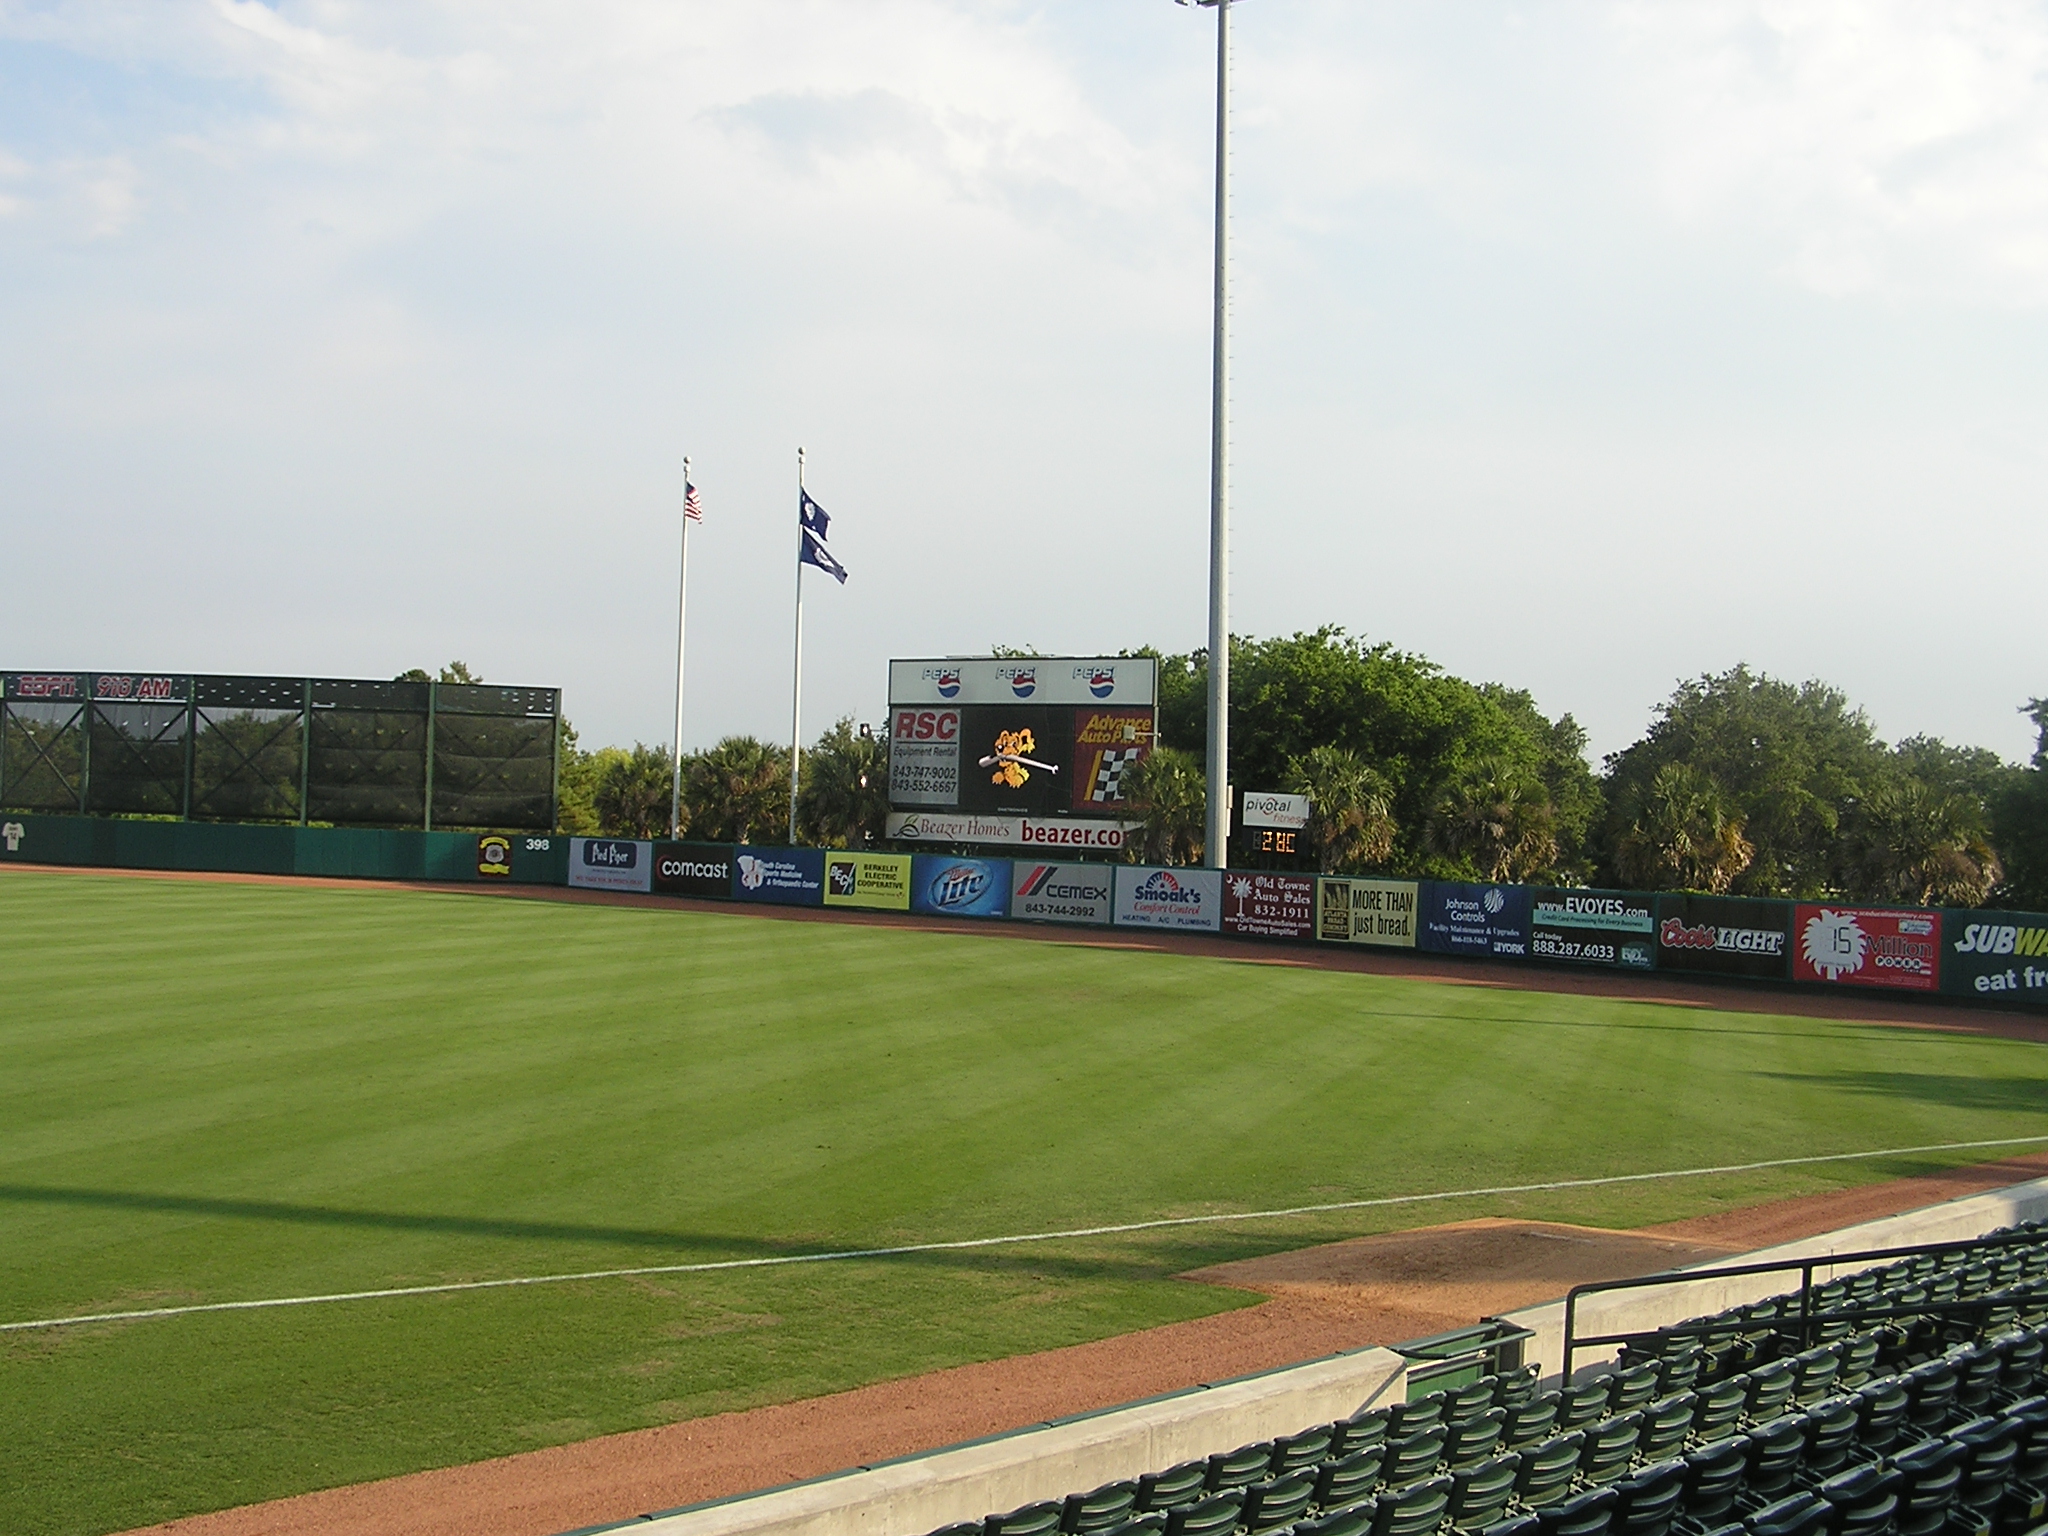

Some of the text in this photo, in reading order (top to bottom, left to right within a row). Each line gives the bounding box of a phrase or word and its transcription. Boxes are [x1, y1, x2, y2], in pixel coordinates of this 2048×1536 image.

[922, 667, 962, 680] PEPSI
[995, 666, 1039, 680] PEPSI
[1072, 666, 1117, 680] PEPSI
[19, 676, 76, 697] ESPN
[97, 676, 172, 697] 910 AM
[895, 712, 958, 740] RSC
[1085, 714, 1152, 731] Advance
[1077, 730, 1112, 743] Auto
[894, 746, 957, 758] Equipment Rental
[893, 765, 956, 779] 843-747-9002
[891, 779, 957, 793] 843-552-6667
[1246, 800, 1291, 812] pivotal
[920, 818, 1010, 839] Beazer Homes
[526, 838, 550, 850] 398
[591, 842, 629, 865] Pied Piper
[661, 861, 728, 878] comcast
[863, 864, 899, 872] BERKELEY
[857, 879, 904, 889] COOPERATIVE
[865, 872, 897, 881] ELECTRIC
[1255, 876, 1310, 891] Old Towne
[1046, 885, 1107, 900] CEMEX
[1135, 886, 1201, 903] Smoak's
[1253, 888, 1311, 905] Auto Sales
[1133, 901, 1201, 915] Comfort Control
[1353, 890, 1413, 912] MORE THAN
[1445, 899, 1479, 911] Johnson
[1537, 897, 1649, 918] www.EVOYES.com
[1026, 903, 1095, 917] 843-744-2992
[1254, 904, 1309, 919] 832-1911
[1451, 911, 1485, 923] Controls
[1123, 914, 1211, 927] HEATING A/C PLUMBING
[1353, 913, 1410, 936] just bread.
[1532, 931, 1563, 942] Call today
[1661, 917, 1785, 956] Coors LIGHT
[1833, 927, 1851, 954] 15
[1500, 942, 1525, 955] YORK
[1533, 940, 1614, 959] 888.287.6033
[1866, 936, 1932, 958] Million
[1974, 965, 2048, 991] eat fr
